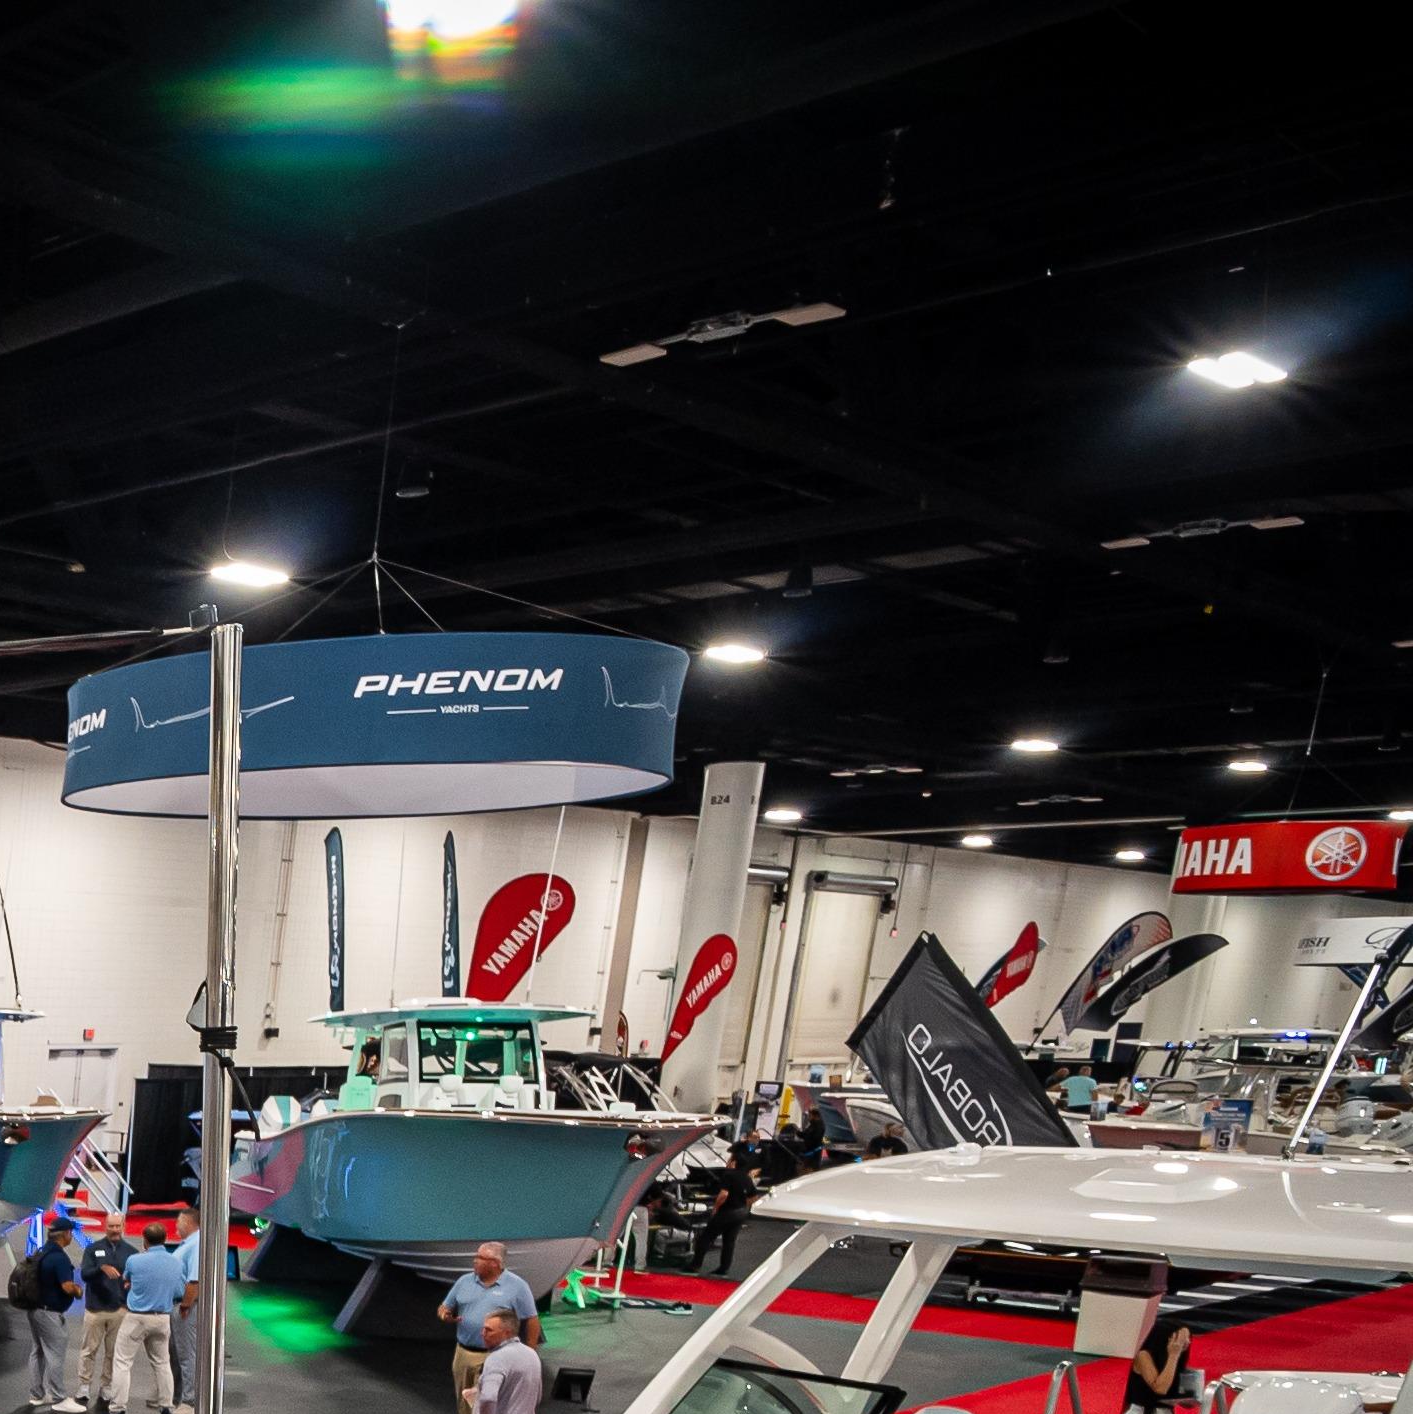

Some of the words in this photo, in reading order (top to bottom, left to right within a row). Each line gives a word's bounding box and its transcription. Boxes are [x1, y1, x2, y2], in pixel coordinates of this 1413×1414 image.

[354, 668, 564, 698] PHENOM
[440, 704, 479, 714] YACHTS
[482, 909, 548, 977] YAMAHA
[685, 964, 723, 1008] YAMAHA
